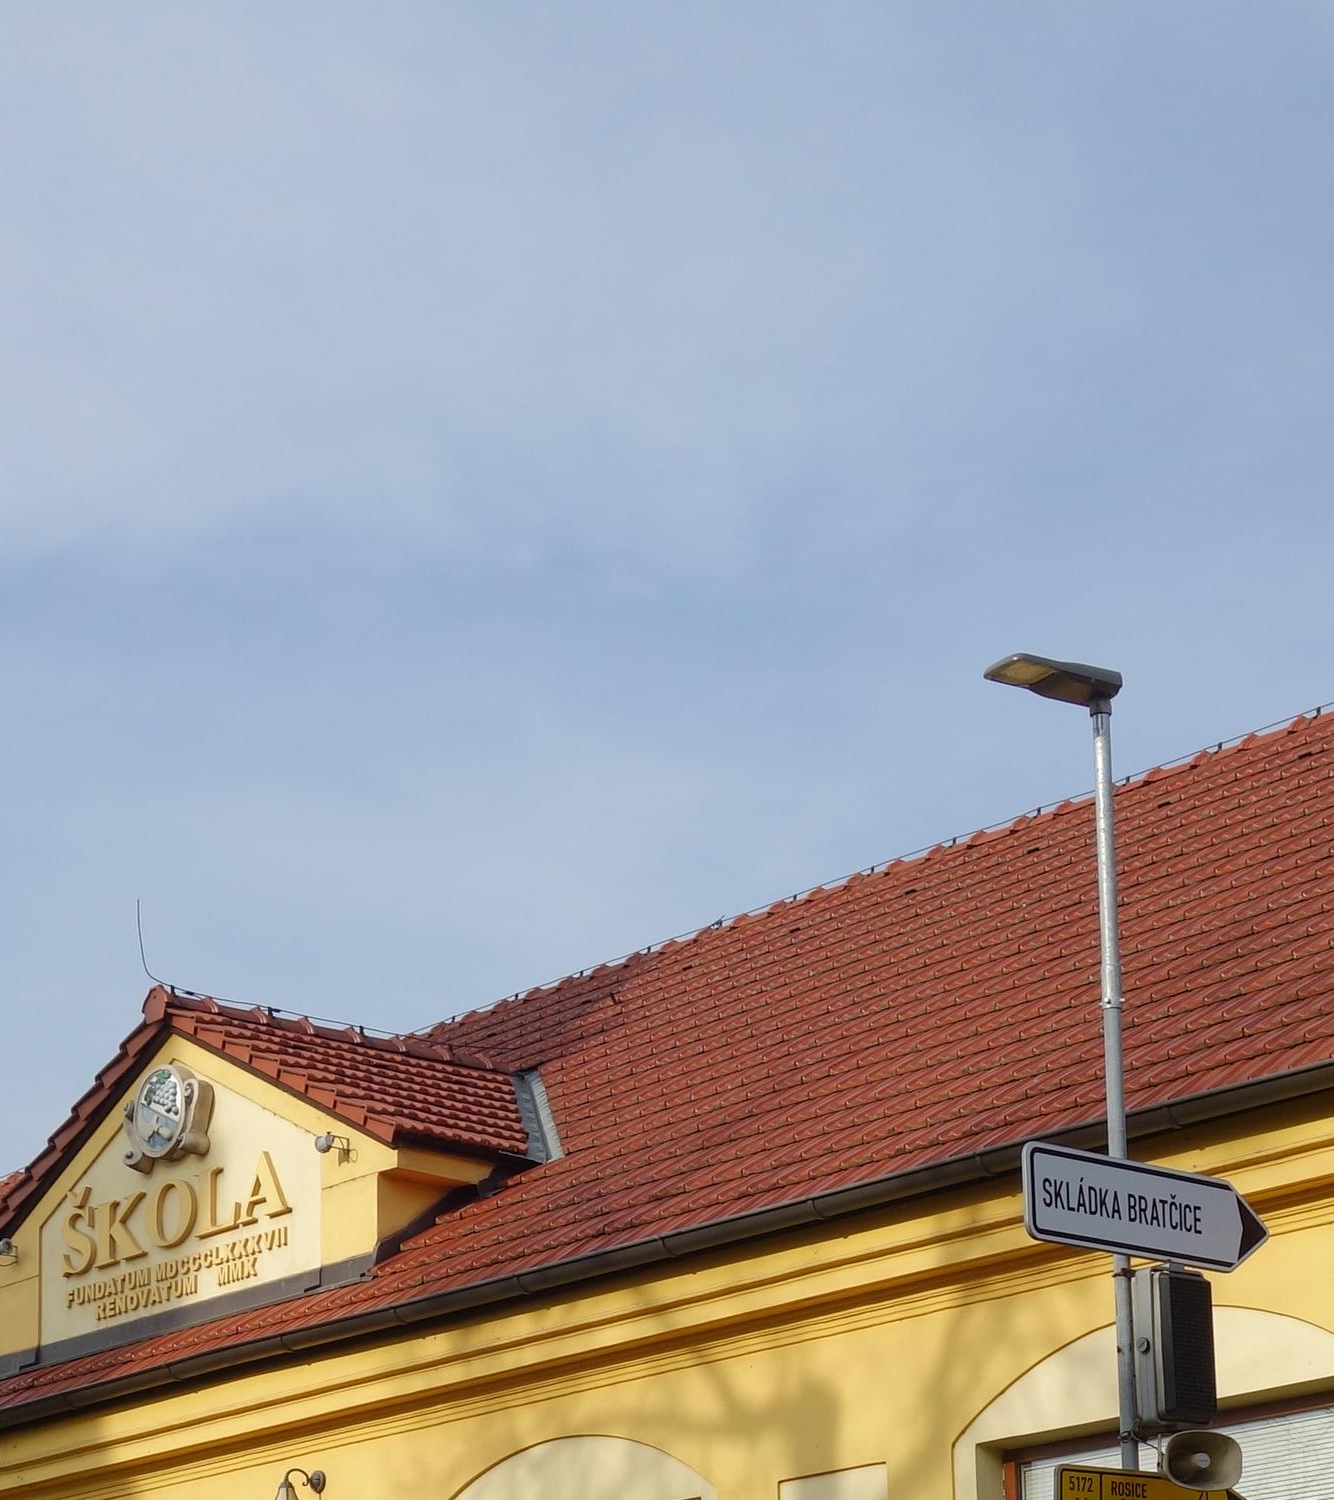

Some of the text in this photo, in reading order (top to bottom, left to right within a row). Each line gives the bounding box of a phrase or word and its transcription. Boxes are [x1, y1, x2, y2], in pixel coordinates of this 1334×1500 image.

[62, 1151, 293, 1277] ŠKOLA
[1042, 1177, 1203, 1235] SKLÁDKA BRATČICE
[67, 1226, 288, 1309] FUNDATUM MDCCCLXXXVII
[95, 1256, 258, 1321] RENOVATUM MMX
[1069, 1475, 1094, 1493] 5172
[1111, 1480, 1148, 1499] ROSICE
